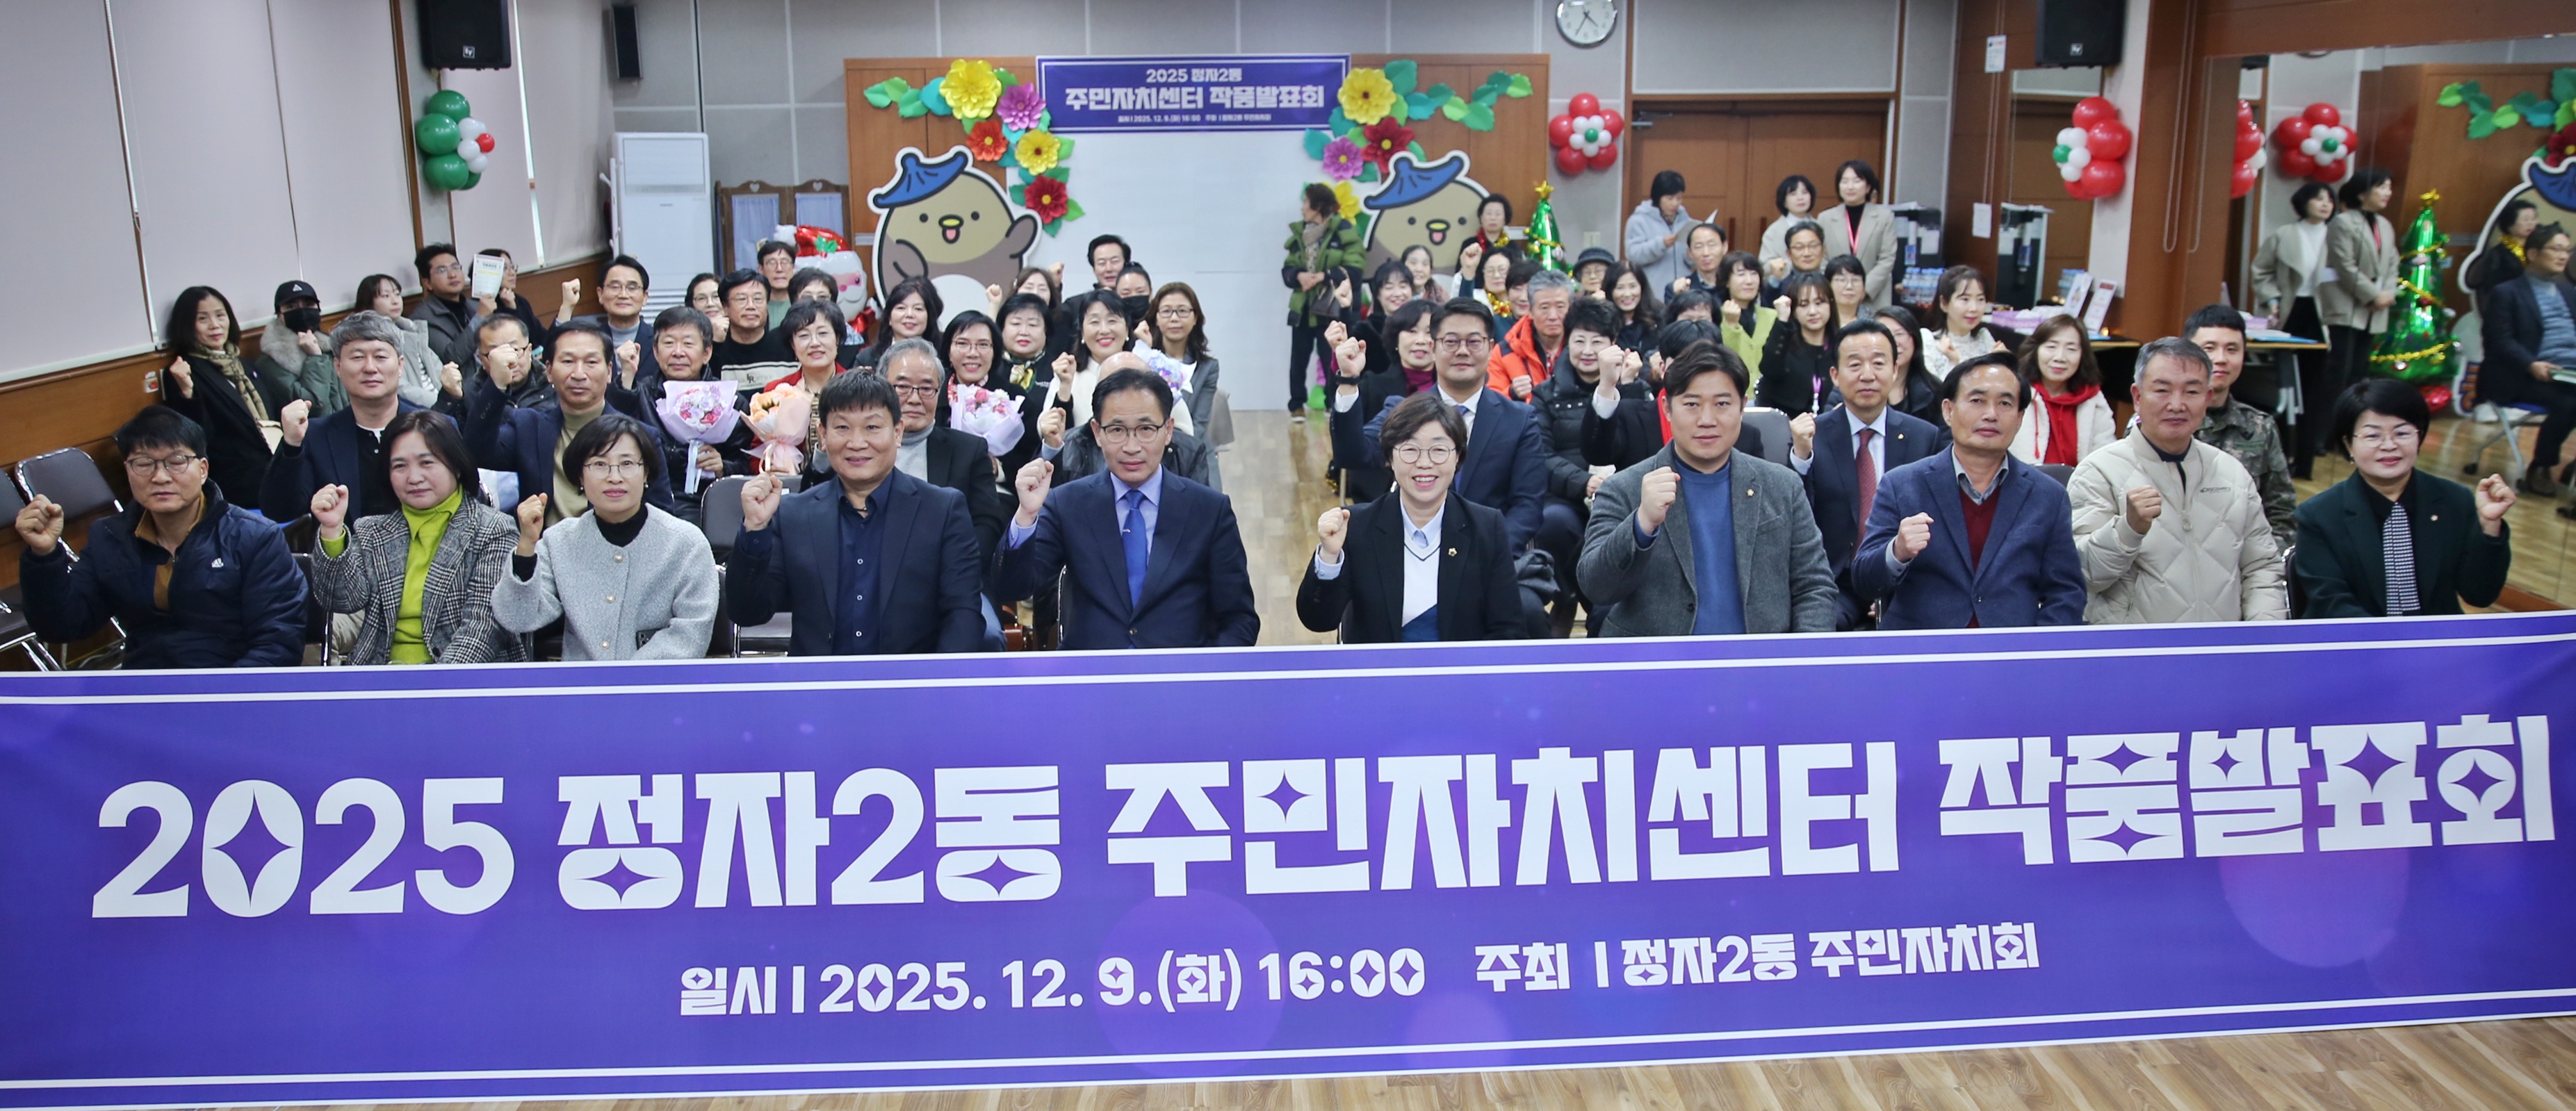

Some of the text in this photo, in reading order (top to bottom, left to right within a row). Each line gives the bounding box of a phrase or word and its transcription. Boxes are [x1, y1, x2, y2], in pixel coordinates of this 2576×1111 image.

[1065, 85, 1325, 110] 주민자치센터 작품발표회
[1146, 68, 1243, 83] 2025 정자2동
[92, 714, 2555, 917] 2025 정자2동 주민자치센터 작품발표회
[680, 966, 777, 1016] 일시
[820, 961, 986, 1012] 2025.
[1002, 959, 1084, 1008] 12.
[1099, 949, 1242, 1012] 9.(화)
[1260, 948, 1425, 1001] 16:00
[1475, 941, 1570, 992] 주최
[1622, 934, 1798, 987] 정자2동
[1809, 922, 2039, 978] 주민자치회
